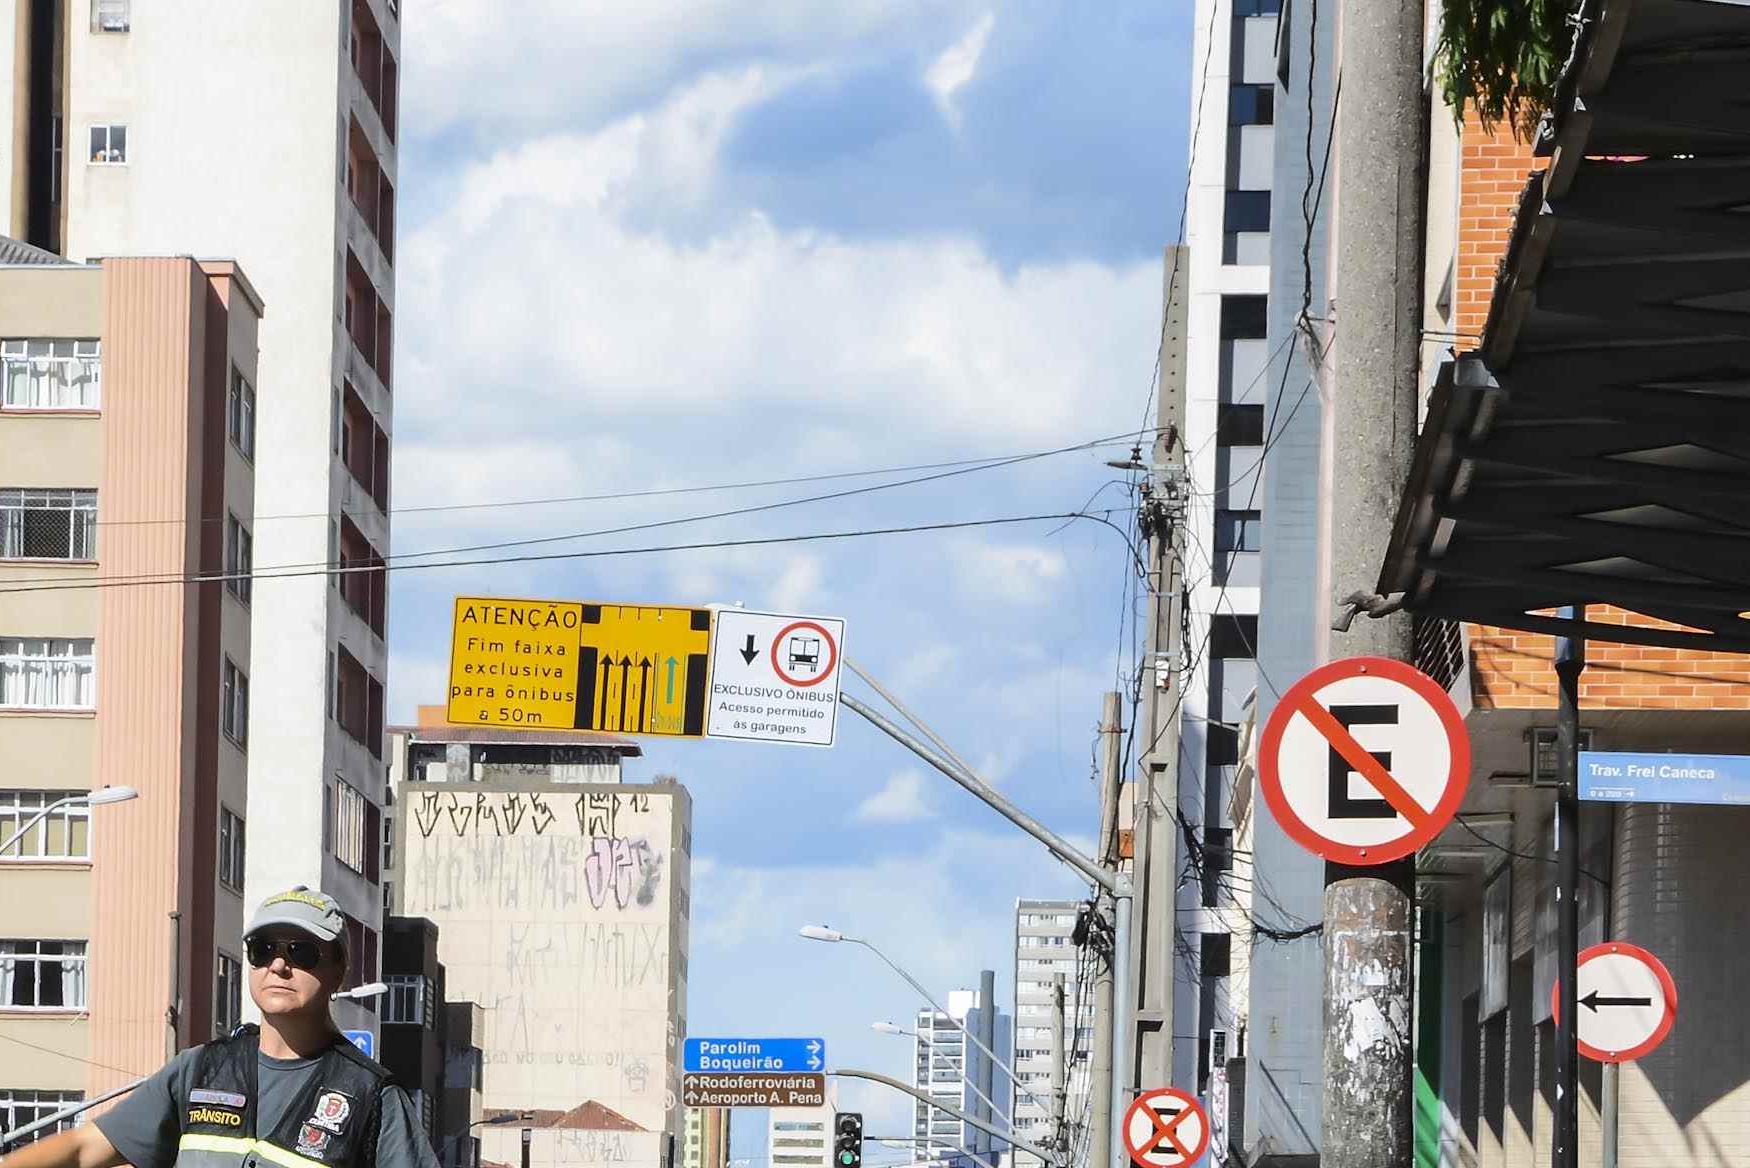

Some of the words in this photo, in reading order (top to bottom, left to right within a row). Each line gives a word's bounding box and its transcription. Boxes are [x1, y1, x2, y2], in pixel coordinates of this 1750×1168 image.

[462, 604, 578, 632] ATENÇÃO
[467, 637, 506, 654] Fim
[514, 638, 567, 657] faixa
[464, 661, 564, 680] exclusiva
[451, 686, 495, 703] para
[505, 685, 574, 703] ônibus
[714, 684, 784, 701] EXCLUSIVO
[789, 685, 834, 704] ÔNIBUS
[479, 710, 489, 721] a
[499, 708, 542, 724] 50m
[719, 703, 763, 716] Acesso
[766, 706, 825, 722] permitido
[750, 721, 807, 737] garagens
[1589, 764, 1622, 777] Trav.
[1627, 765, 1655, 778] Frei
[1659, 766, 1715, 779] Caneca
[700, 1041, 761, 1055] Parolim
[700, 1056, 783, 1071] Boqueirão
[700, 1076, 816, 1089] Rodoferroviária
[700, 1091, 767, 1105] Aeroporto
[770, 1092, 784, 1104] A.
[789, 1091, 822, 1104] Pena
[189, 1108, 241, 1126] TRÂNSITO
